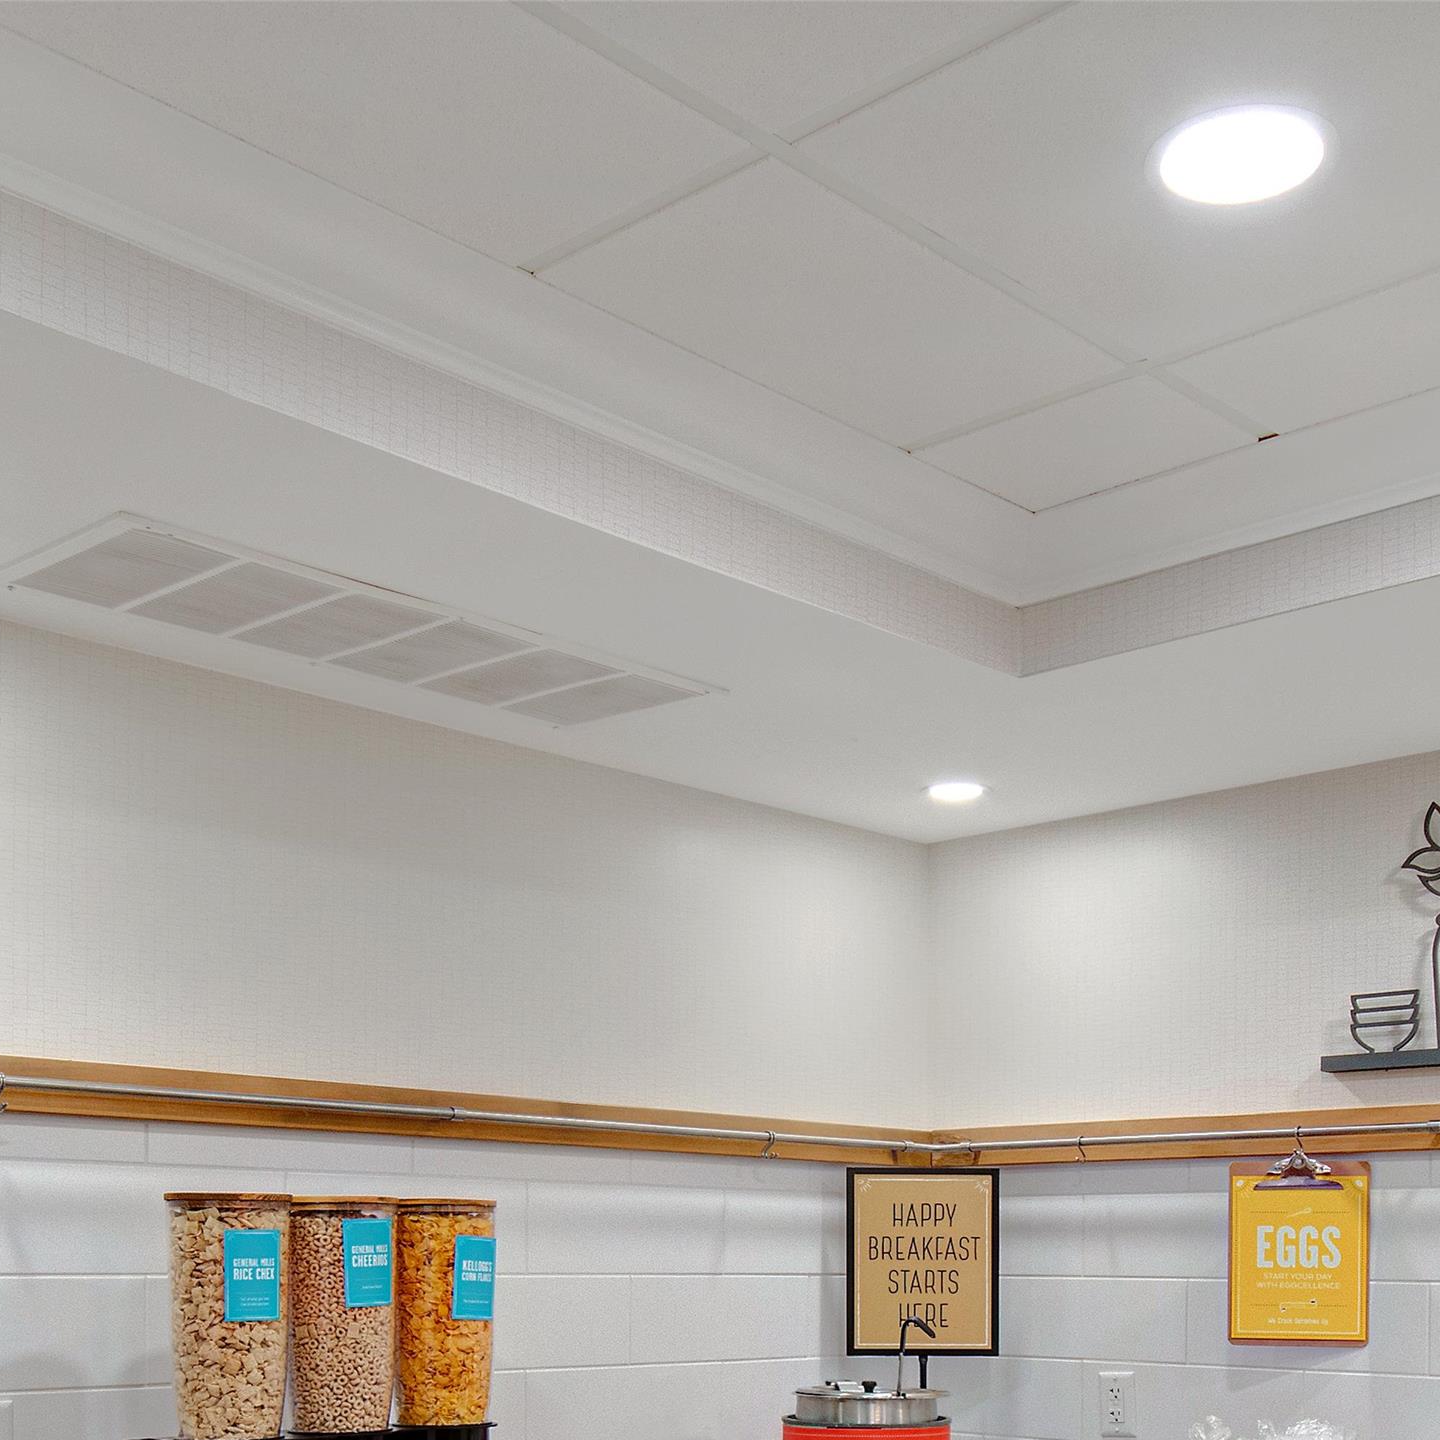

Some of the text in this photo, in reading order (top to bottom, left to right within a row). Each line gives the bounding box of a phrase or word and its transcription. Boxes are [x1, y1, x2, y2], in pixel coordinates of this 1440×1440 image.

[893, 1203, 957, 1227] HAPPY
[352, 1245, 374, 1254] GENERAL
[869, 1236, 981, 1261] BREAKFAST
[1256, 1225, 1342, 1269] EGGS
[233, 1258, 275, 1267] GENERAL MILLS
[352, 1254, 388, 1267] CHEERIOS
[233, 1268, 275, 1280] RICE CHEX
[462, 1272, 477, 1281] CORN
[888, 1269, 960, 1294] STARTS
[899, 1303, 949, 1328] HERE
